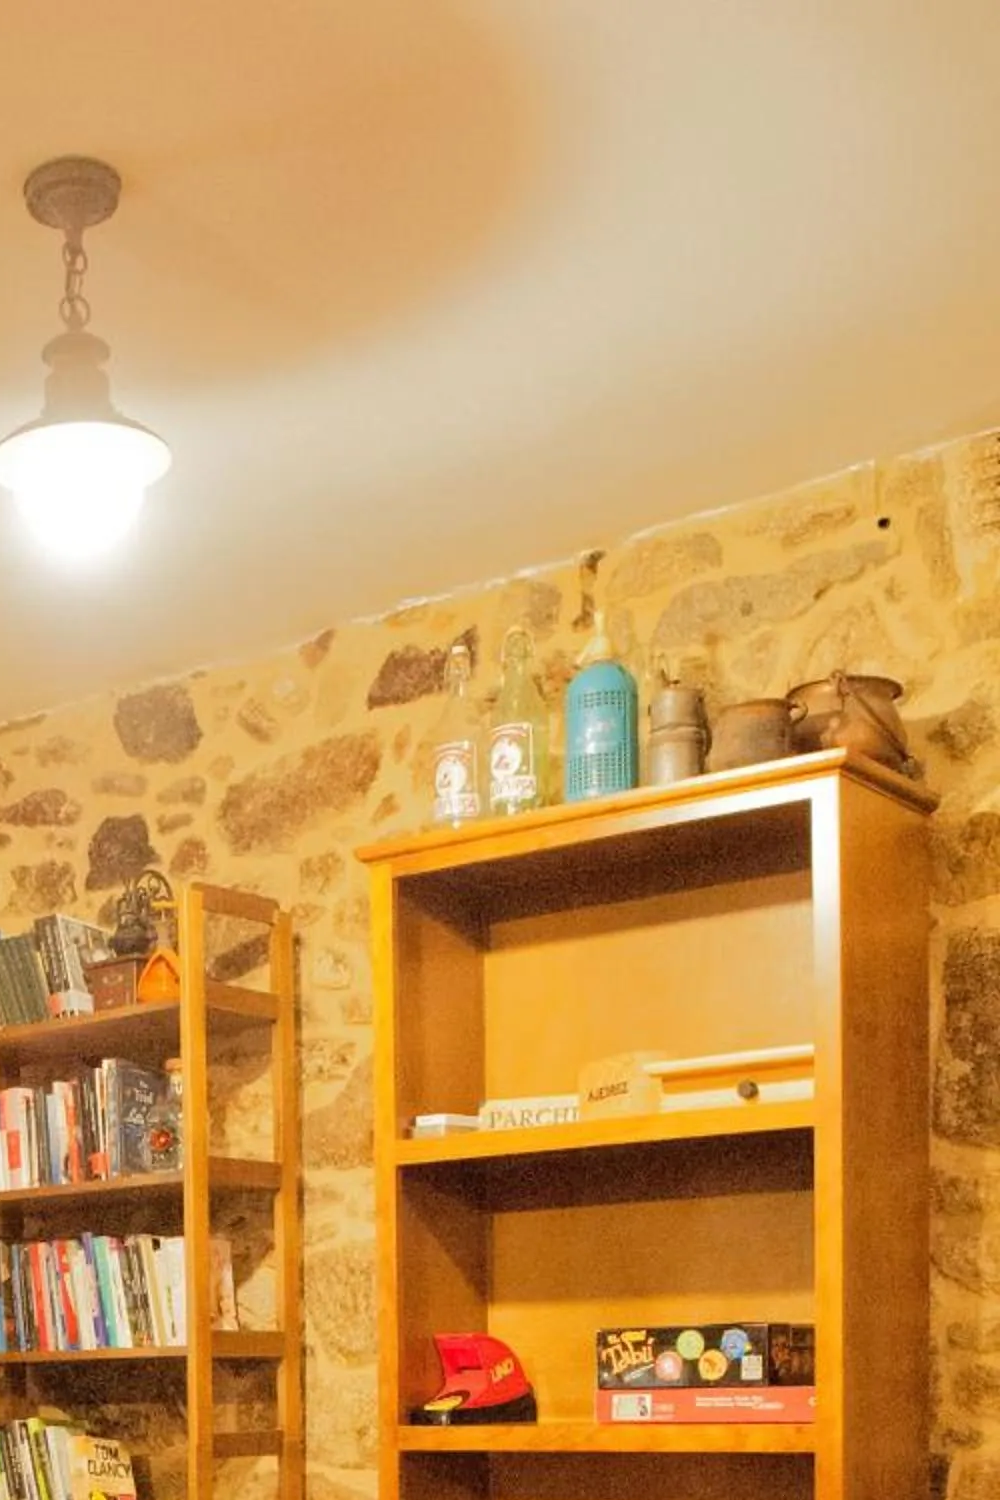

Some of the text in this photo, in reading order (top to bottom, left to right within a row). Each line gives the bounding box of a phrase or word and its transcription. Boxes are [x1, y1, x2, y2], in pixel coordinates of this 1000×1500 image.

[490, 1358, 515, 1383] UNO
[94, 1443, 120, 1461] TOM
[88, 1459, 131, 1479] CLANCY
